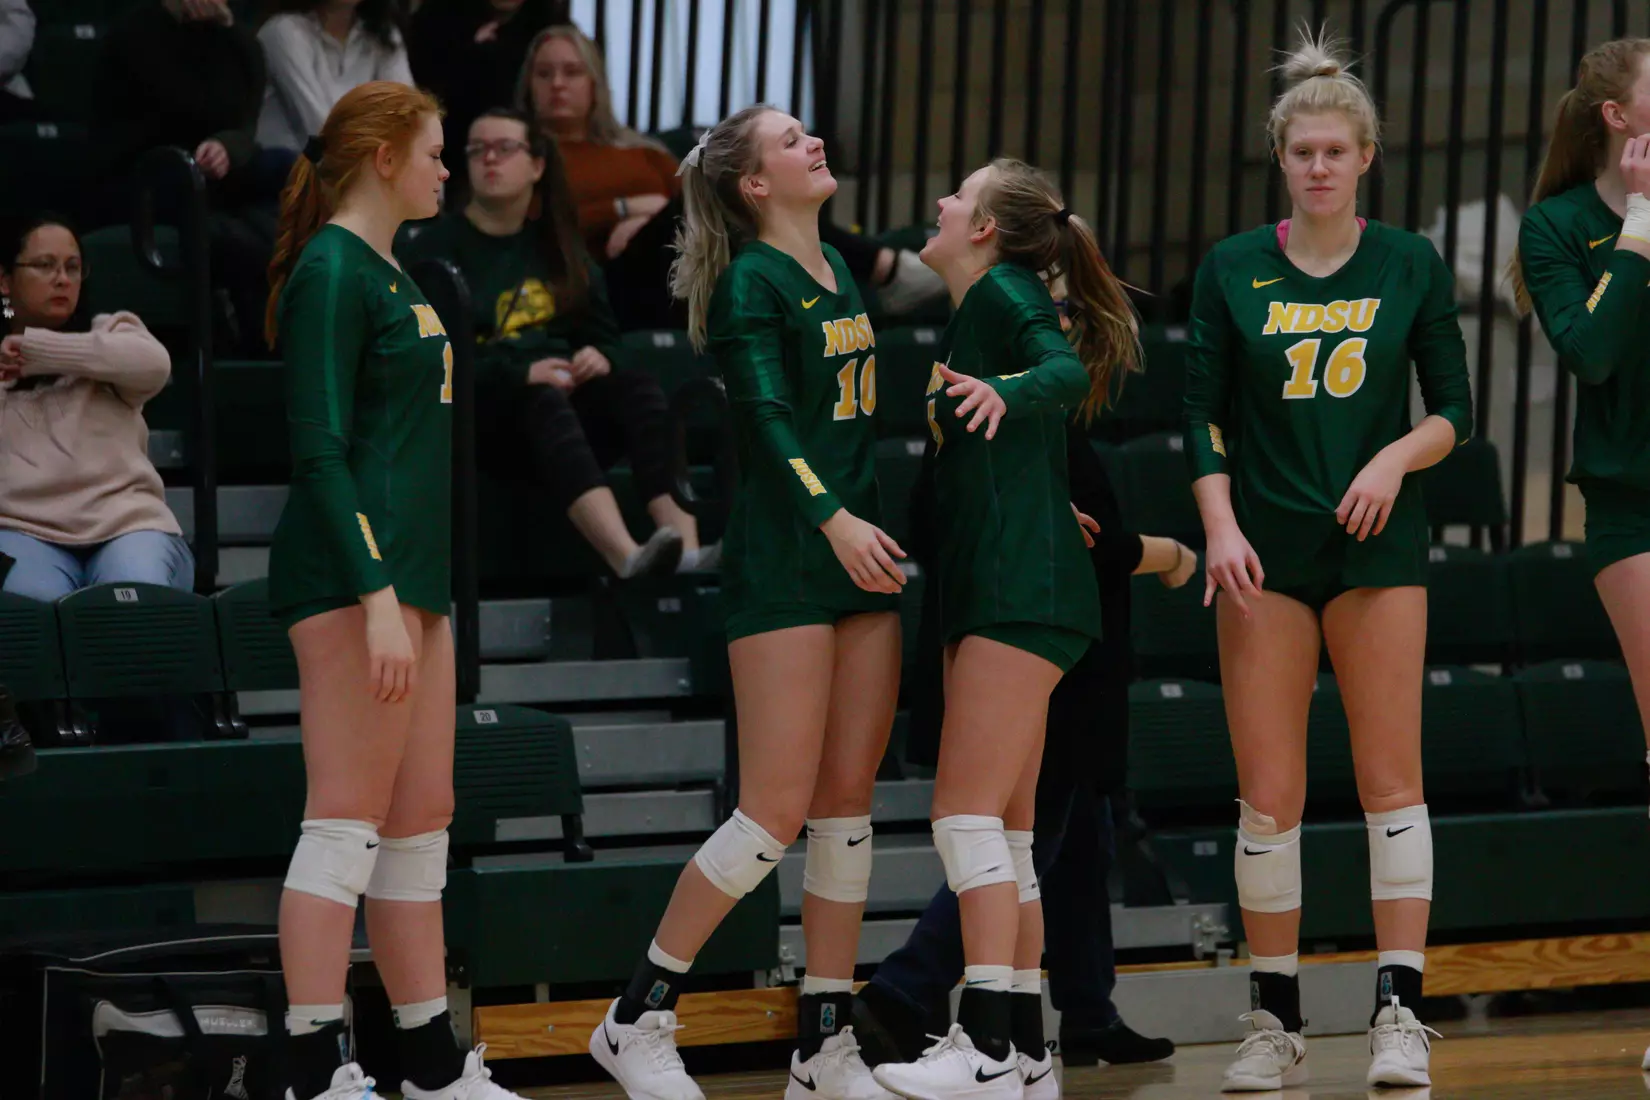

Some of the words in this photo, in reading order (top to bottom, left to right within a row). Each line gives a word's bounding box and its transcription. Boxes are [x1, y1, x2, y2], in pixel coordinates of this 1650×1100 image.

[1262, 298, 1381, 335] NDSU
[833, 354, 877, 421] 10
[1282, 337, 1368, 399] 16
